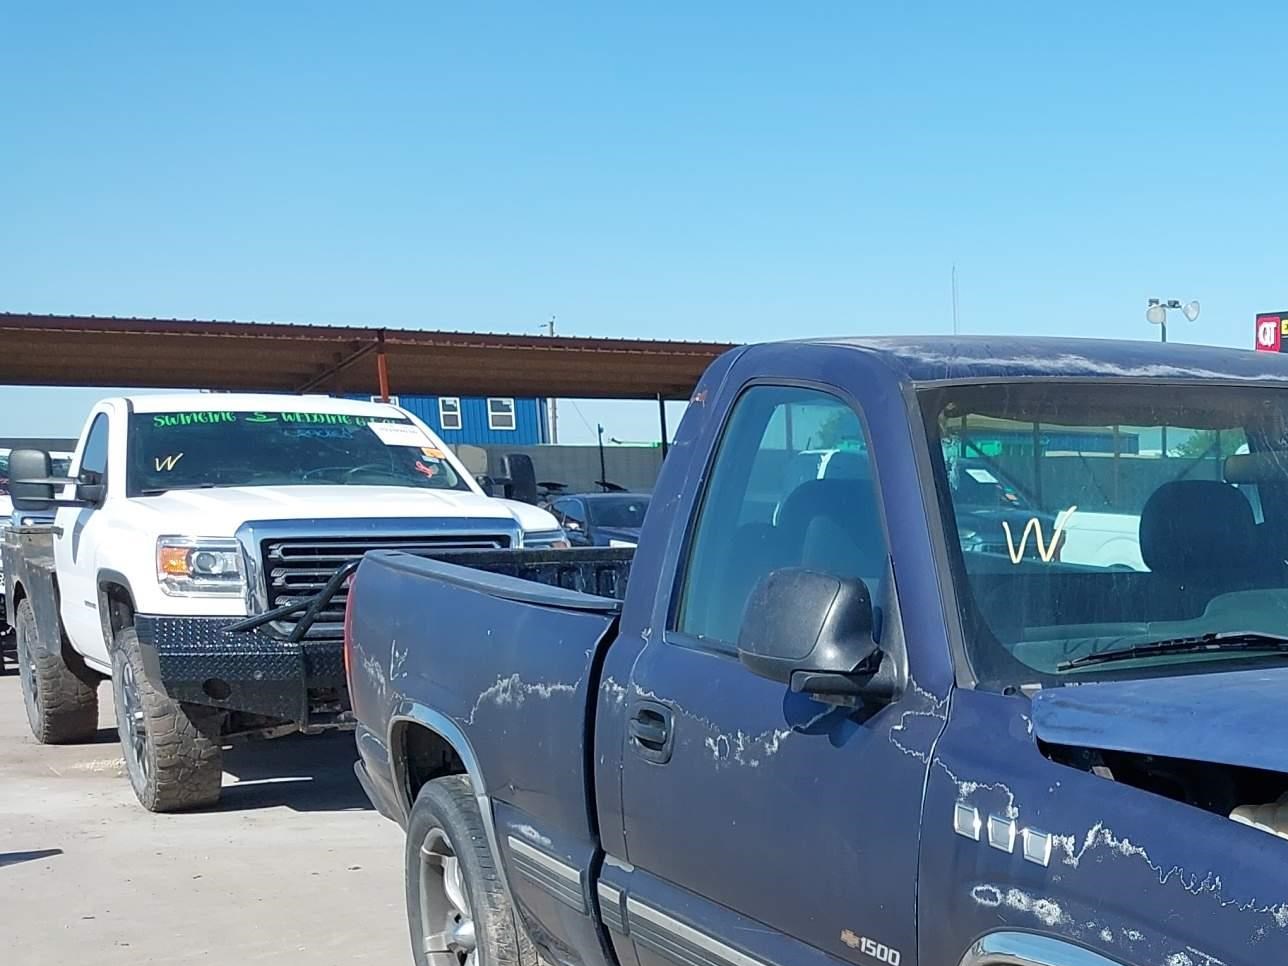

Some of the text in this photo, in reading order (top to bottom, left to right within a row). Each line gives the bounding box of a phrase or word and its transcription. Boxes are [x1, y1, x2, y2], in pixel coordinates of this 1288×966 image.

[1258, 321, 1277, 346] QT
[154, 411, 236, 427] SWINGING
[1002, 505, 1077, 564] W
